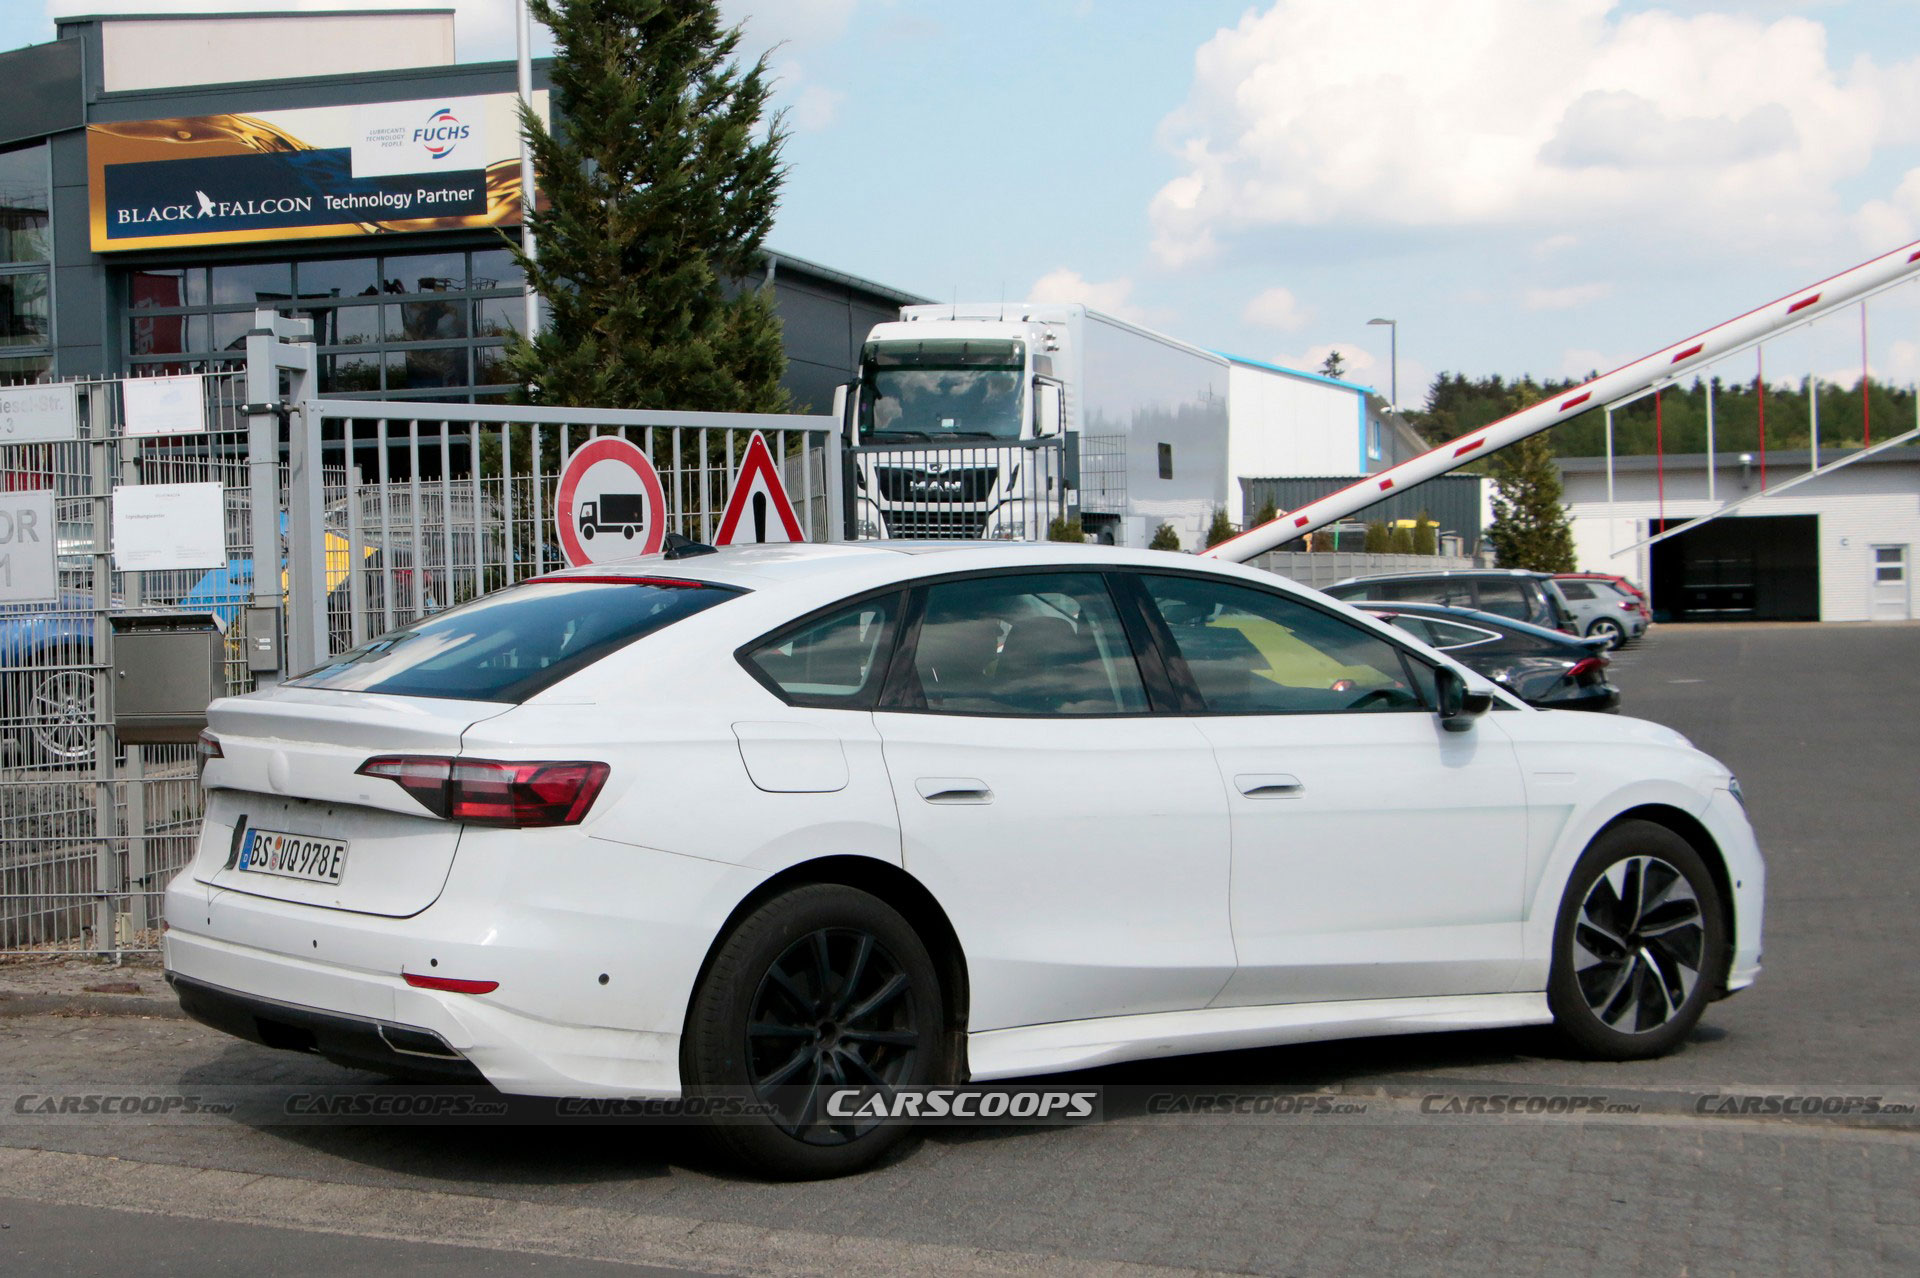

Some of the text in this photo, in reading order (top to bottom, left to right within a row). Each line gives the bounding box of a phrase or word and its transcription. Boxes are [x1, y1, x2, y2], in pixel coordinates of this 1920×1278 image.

[413, 125, 470, 142] FUCHS
[118, 197, 312, 224] BLACK FALCON
[324, 188, 475, 210] Technology Partner
[250, 835, 272, 867] BS
